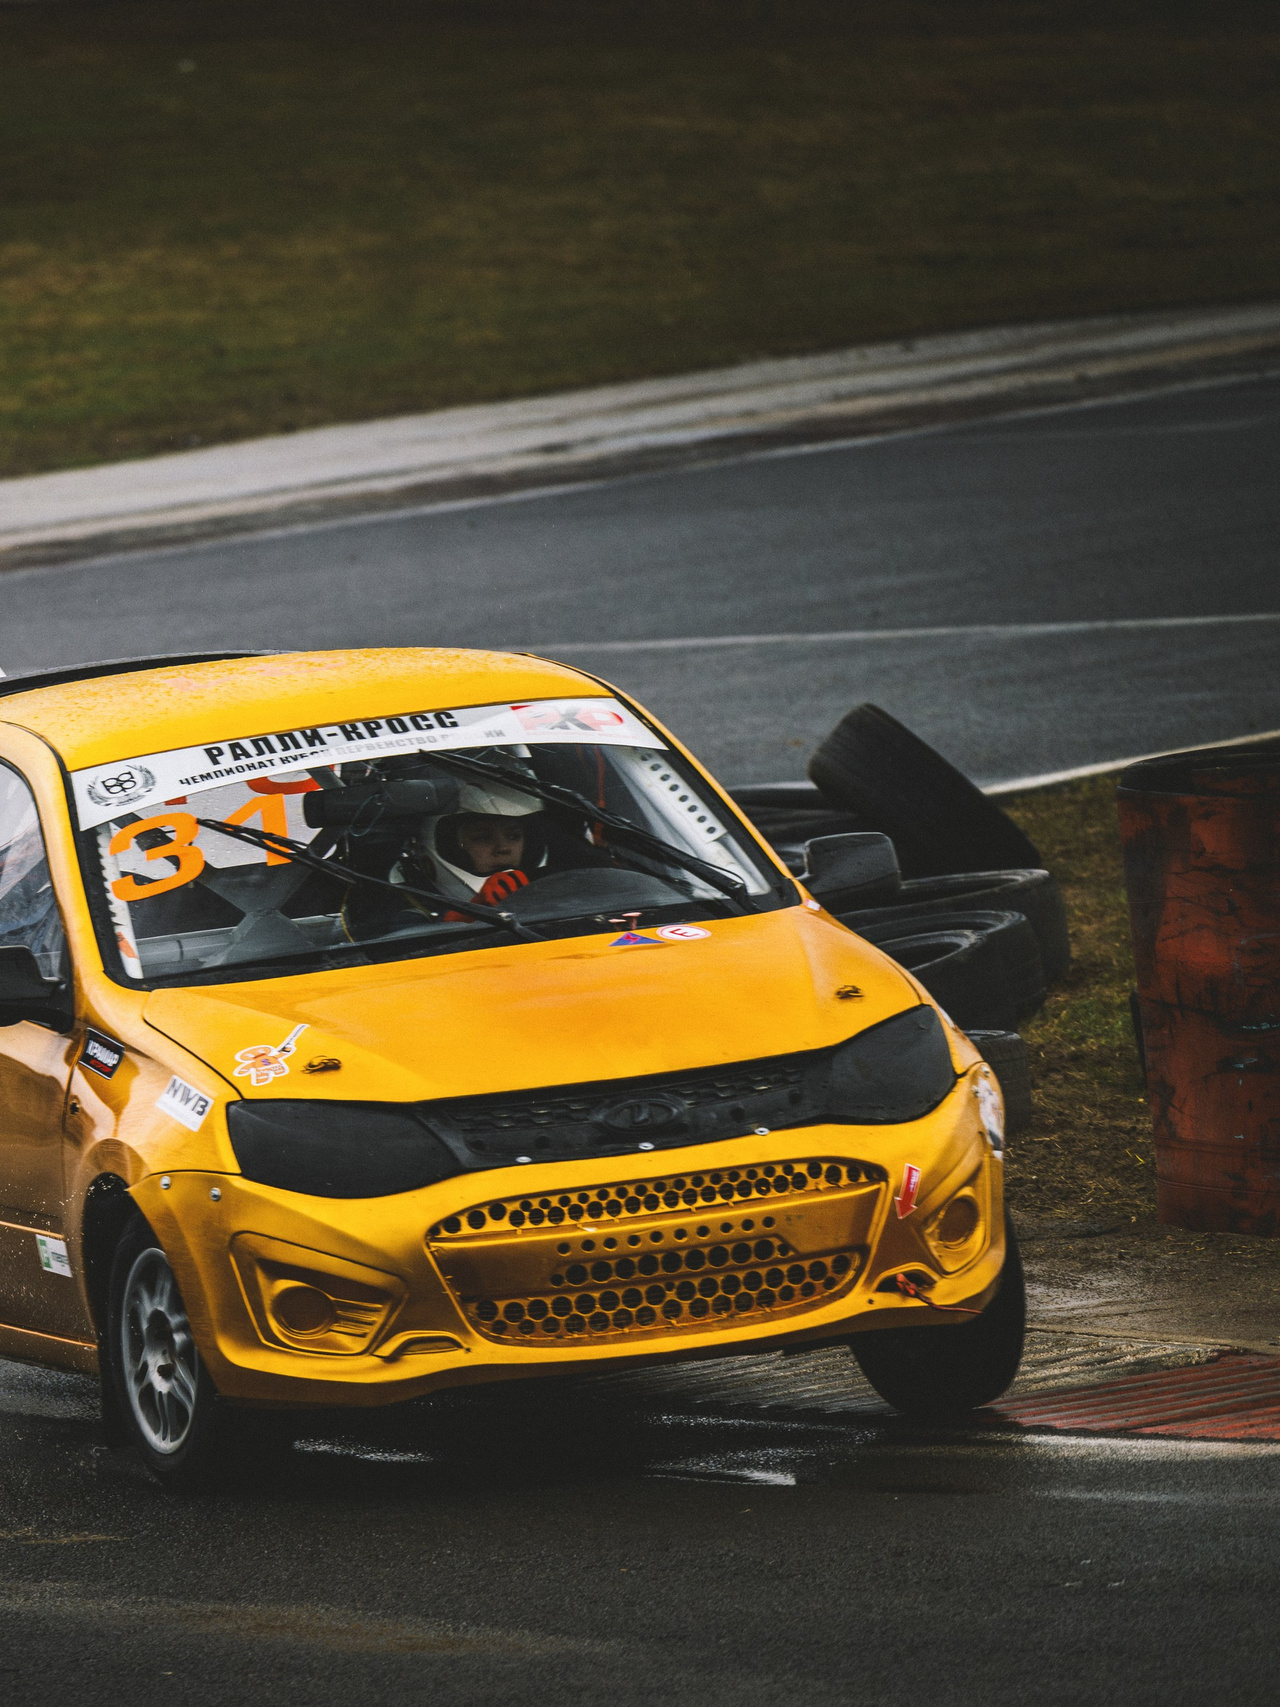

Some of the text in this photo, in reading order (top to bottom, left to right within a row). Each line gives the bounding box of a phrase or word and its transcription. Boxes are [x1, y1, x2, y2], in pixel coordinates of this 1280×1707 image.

[203, 711, 459, 766] РАЛЛИ-КРОСС
[179, 758, 276, 786] ЧЕМПИОНАТ
[108, 793, 293, 902] 31
[166, 1076, 211, 1117] NWB
